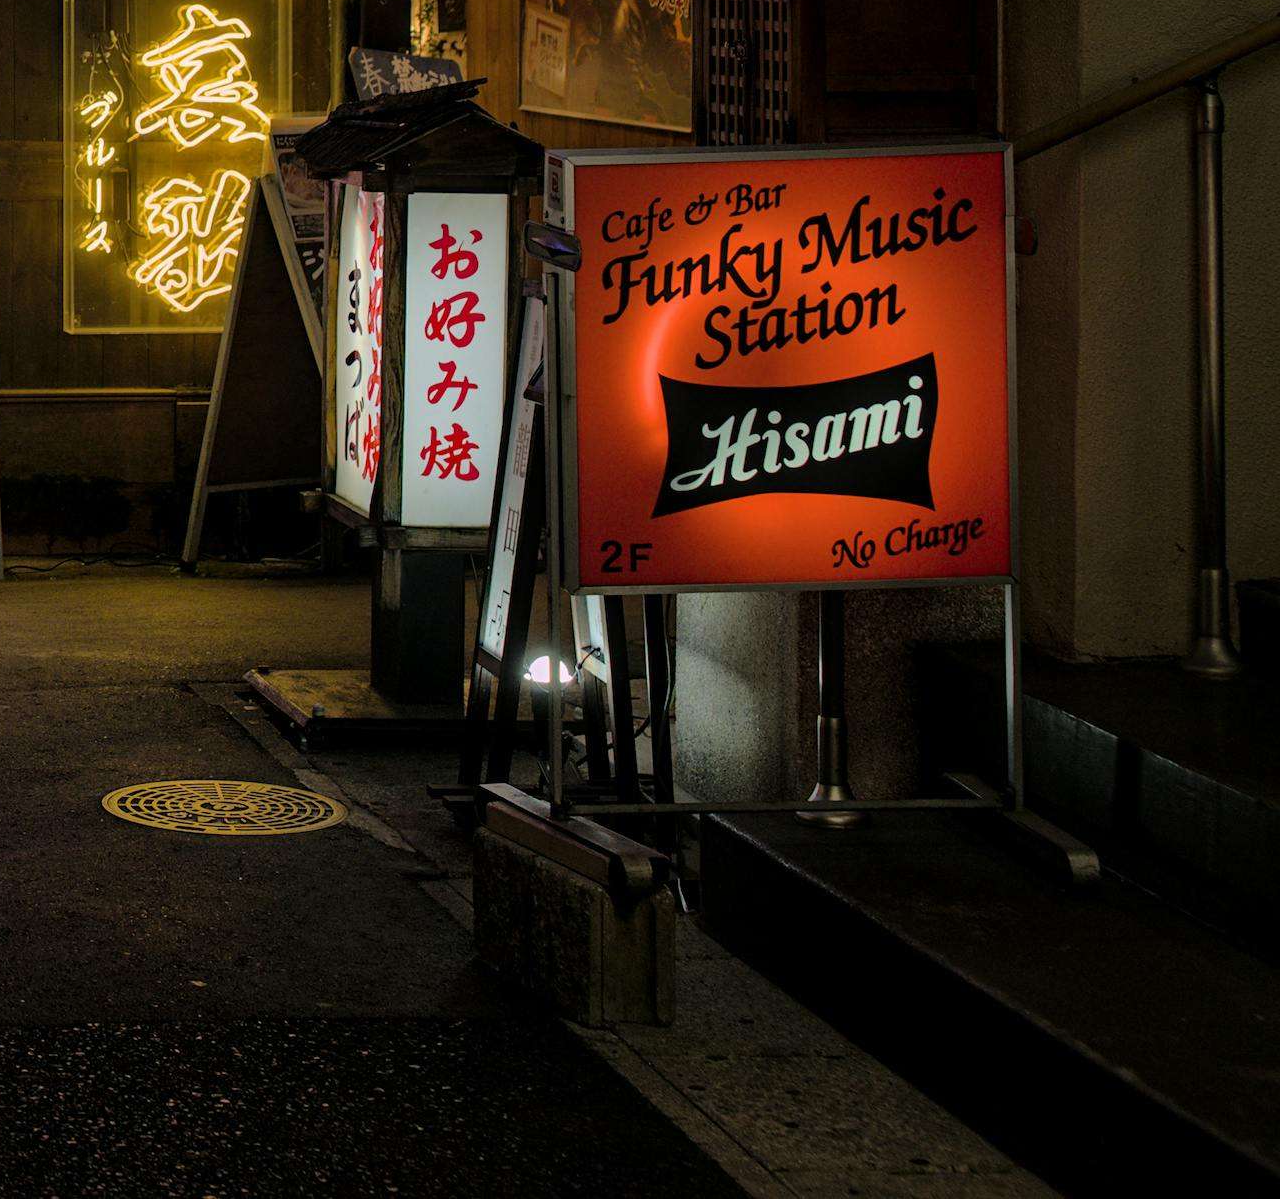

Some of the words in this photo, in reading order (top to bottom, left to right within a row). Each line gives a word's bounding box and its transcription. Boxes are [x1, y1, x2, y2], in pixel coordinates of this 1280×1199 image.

[83, 92, 115, 255] ブルース
[602, 197, 674, 248] Cafe
[684, 193, 718, 225] &
[725, 183, 787, 218] Bar
[601, 223, 784, 325] Funky
[798, 187, 979, 275] Music
[345, 259, 364, 468] まつば
[420, 223, 485, 482] お好み焼
[694, 279, 907, 370] Station
[670, 375, 924, 493] Hisami
[599, 540, 654, 574] 2F
[831, 531, 876, 570] No
[884, 517, 984, 567] Charge
